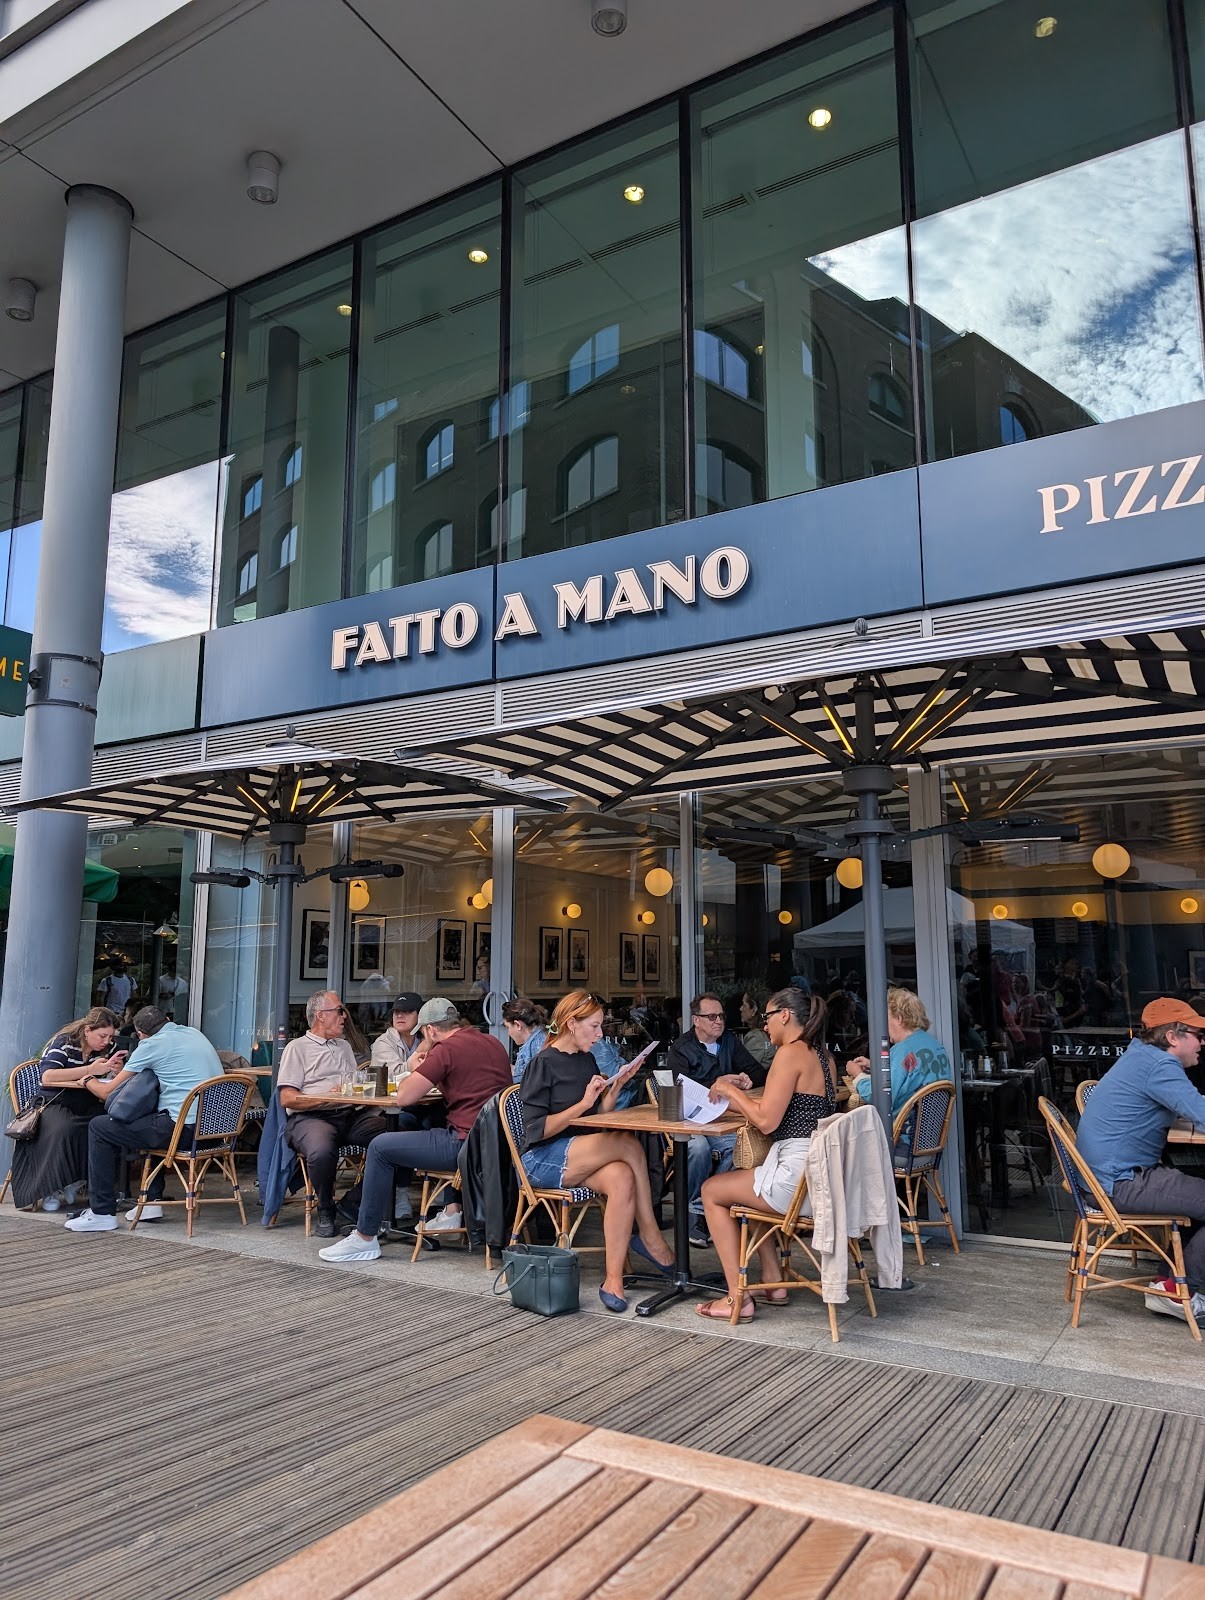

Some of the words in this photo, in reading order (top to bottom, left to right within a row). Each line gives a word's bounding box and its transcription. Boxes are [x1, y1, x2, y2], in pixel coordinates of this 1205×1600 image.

[1037, 454, 1205, 534] PIZZ
[330, 602, 479, 671] FATTO
[494, 591, 539, 641] A
[552, 545, 750, 629] MANO
